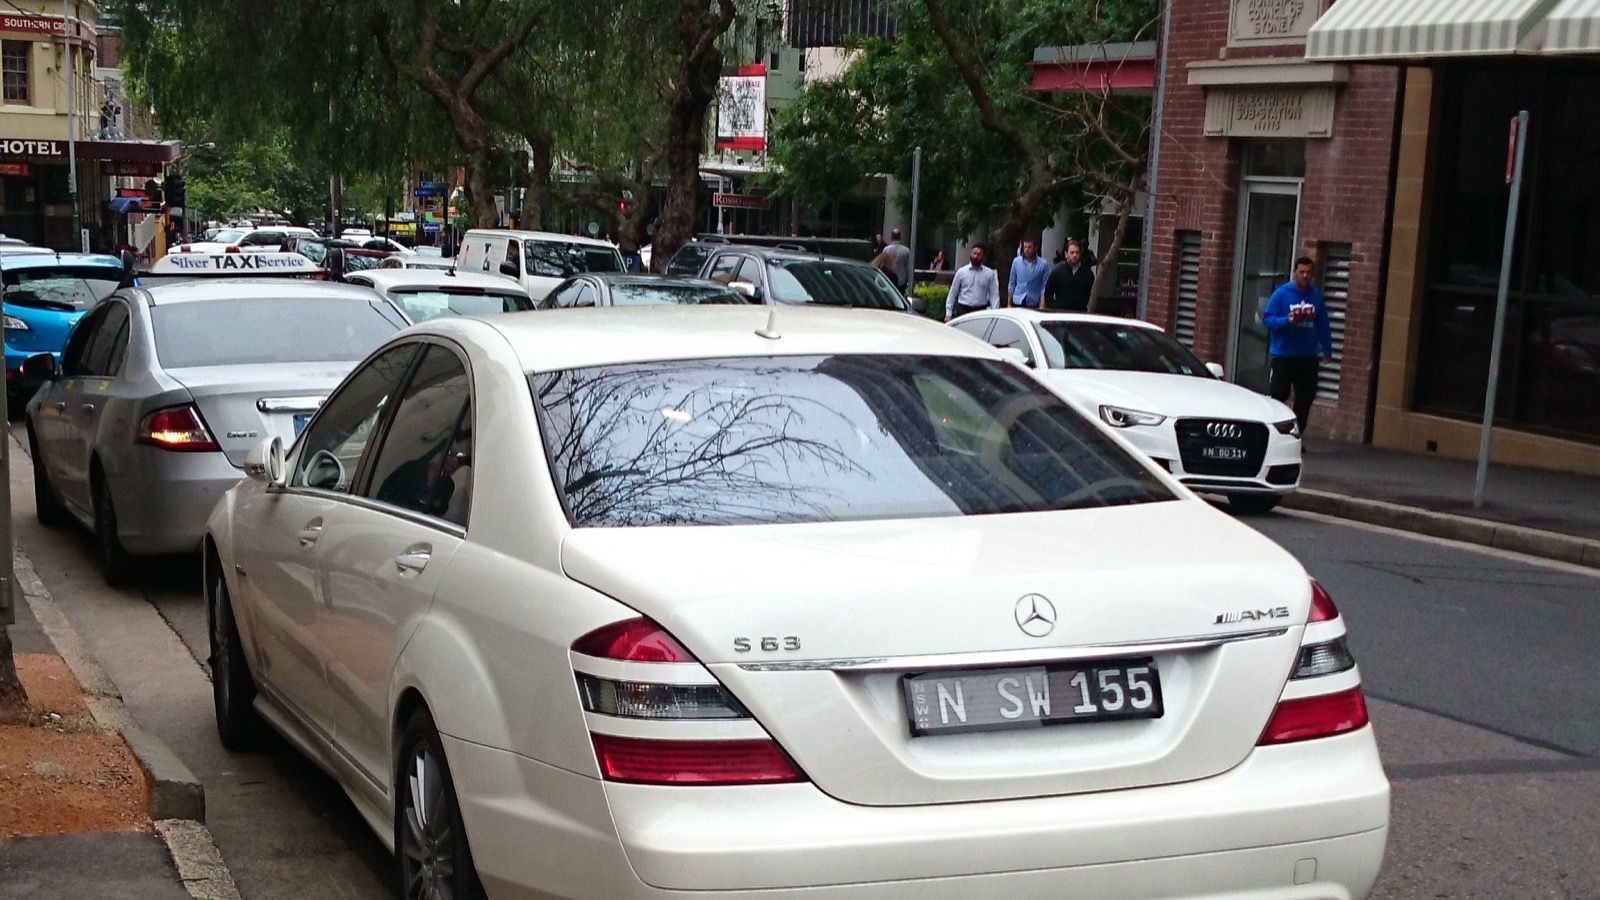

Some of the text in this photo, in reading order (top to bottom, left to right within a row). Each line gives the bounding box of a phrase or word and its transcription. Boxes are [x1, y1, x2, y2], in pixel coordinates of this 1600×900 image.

[4, 18, 51, 30] SOUTHERN
[1254, 20, 1295, 35] SYDNEY
[0, 140, 62, 155] HOTEL
[170, 255, 304, 269] Silver TAXI Service
[1241, 606, 1290, 621] AMG
[734, 635, 801, 652] S 63
[936, 667, 1155, 724] N SW 155
